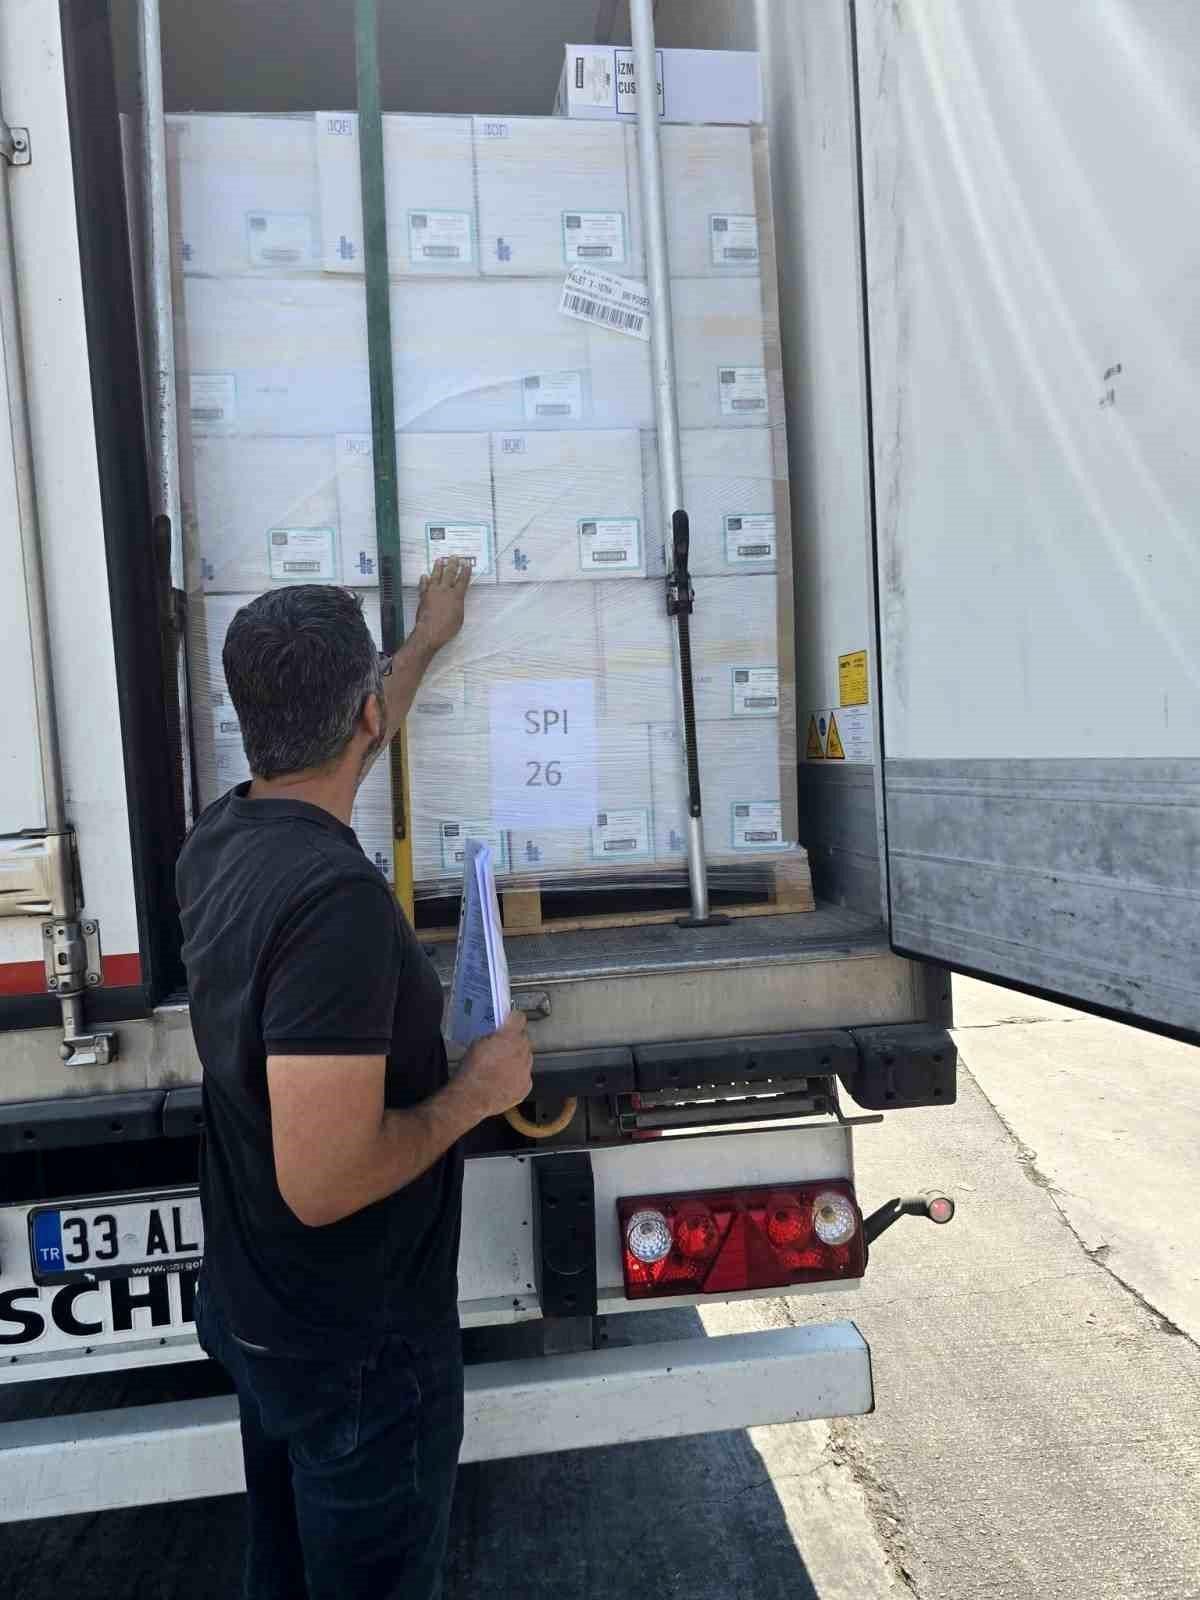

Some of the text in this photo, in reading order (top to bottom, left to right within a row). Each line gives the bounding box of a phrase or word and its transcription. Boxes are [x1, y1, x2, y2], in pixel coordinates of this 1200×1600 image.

[618, 81, 662, 96] CUSS
[524, 709, 568, 735] SPI
[525, 760, 562, 787] 26
[63, 1206, 199, 1263] 33 AL
[40, 1247, 61, 1261] TR
